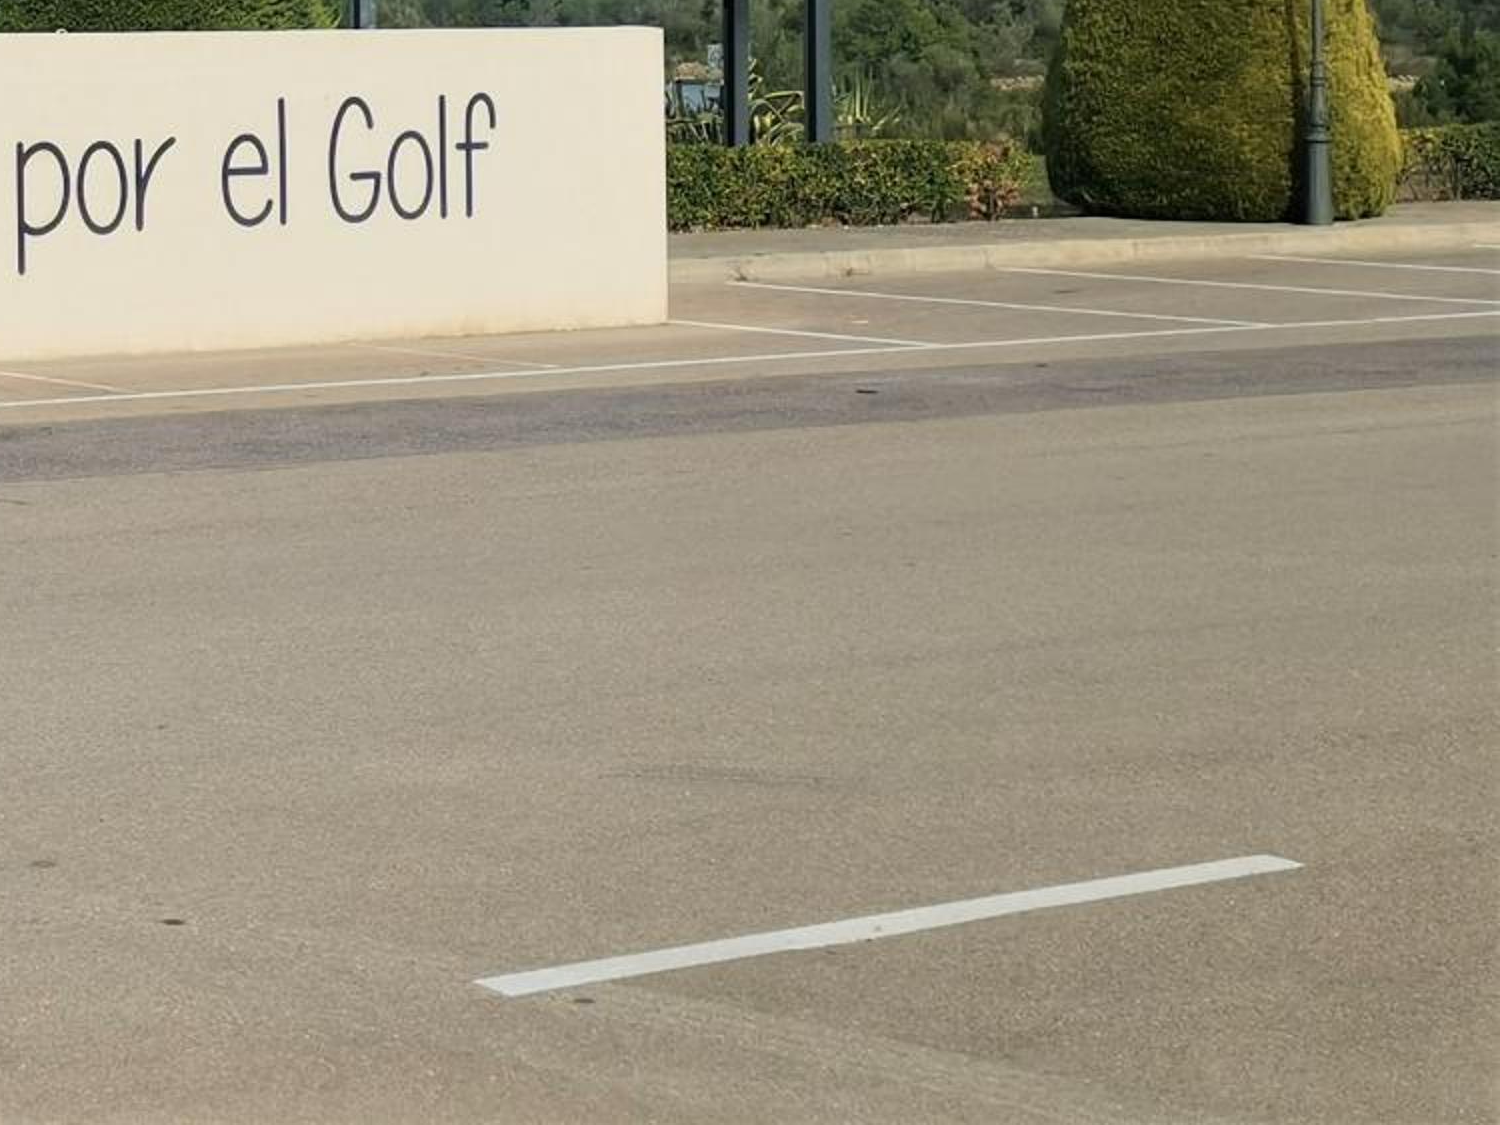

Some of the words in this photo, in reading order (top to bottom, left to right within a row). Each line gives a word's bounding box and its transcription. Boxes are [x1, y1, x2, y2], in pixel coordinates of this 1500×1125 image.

[16, 136, 177, 275] por
[221, 97, 288, 227] el
[327, 91, 497, 223] Golf
